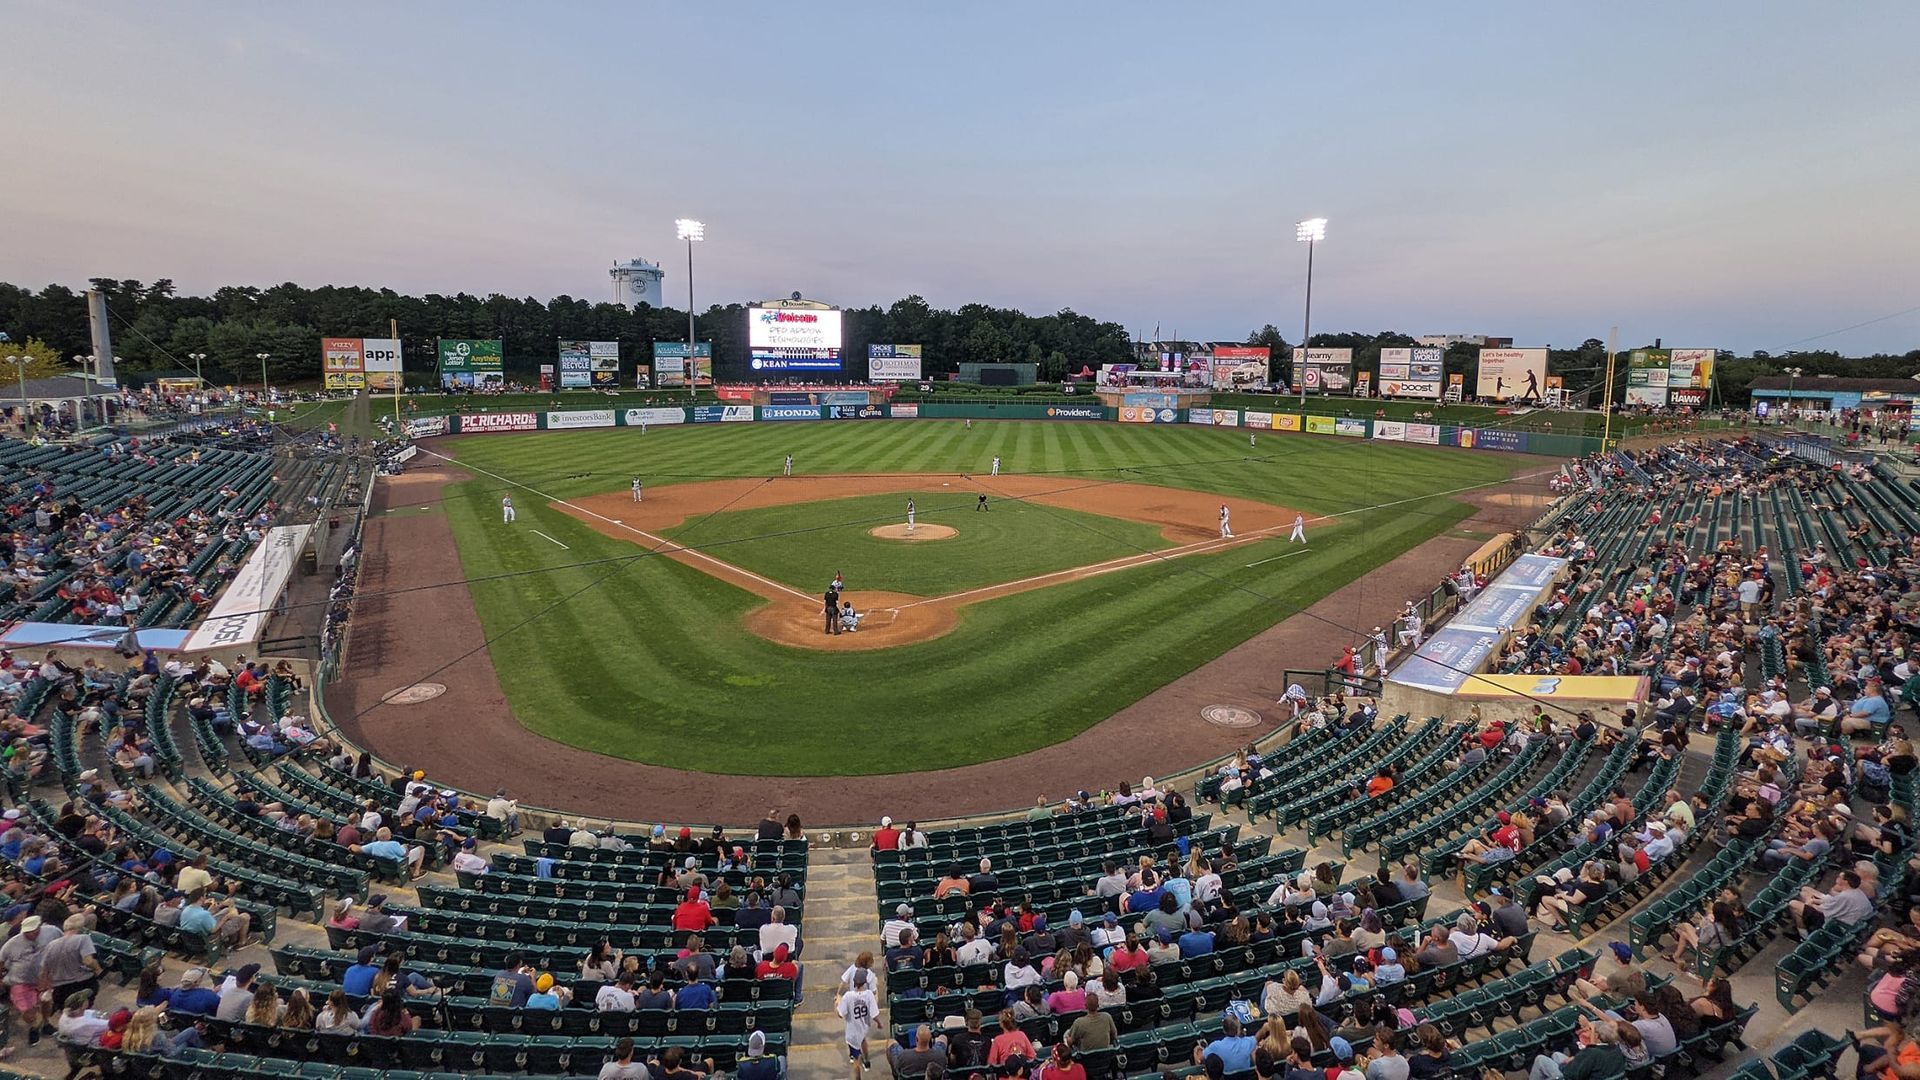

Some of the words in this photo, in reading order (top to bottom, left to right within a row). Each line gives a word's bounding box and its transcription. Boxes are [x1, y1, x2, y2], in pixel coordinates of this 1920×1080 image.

[779, 312, 818, 323] Welcome
[562, 361, 590, 370] RECYCLE
[763, 360, 788, 368] KEAN
[1401, 382, 1433, 392] boost
[1671, 394, 1701, 403] HAWK
[773, 409, 820, 417] HONDA
[859, 408, 882, 418] Corona
[1055, 408, 1091, 417] Provident
[478, 414, 529, 426] RICHARD
[1484, 430, 1517, 438] SUPERIOR
[1513, 838, 1519, 852] 3
[853, 1005, 868, 1020] 99
